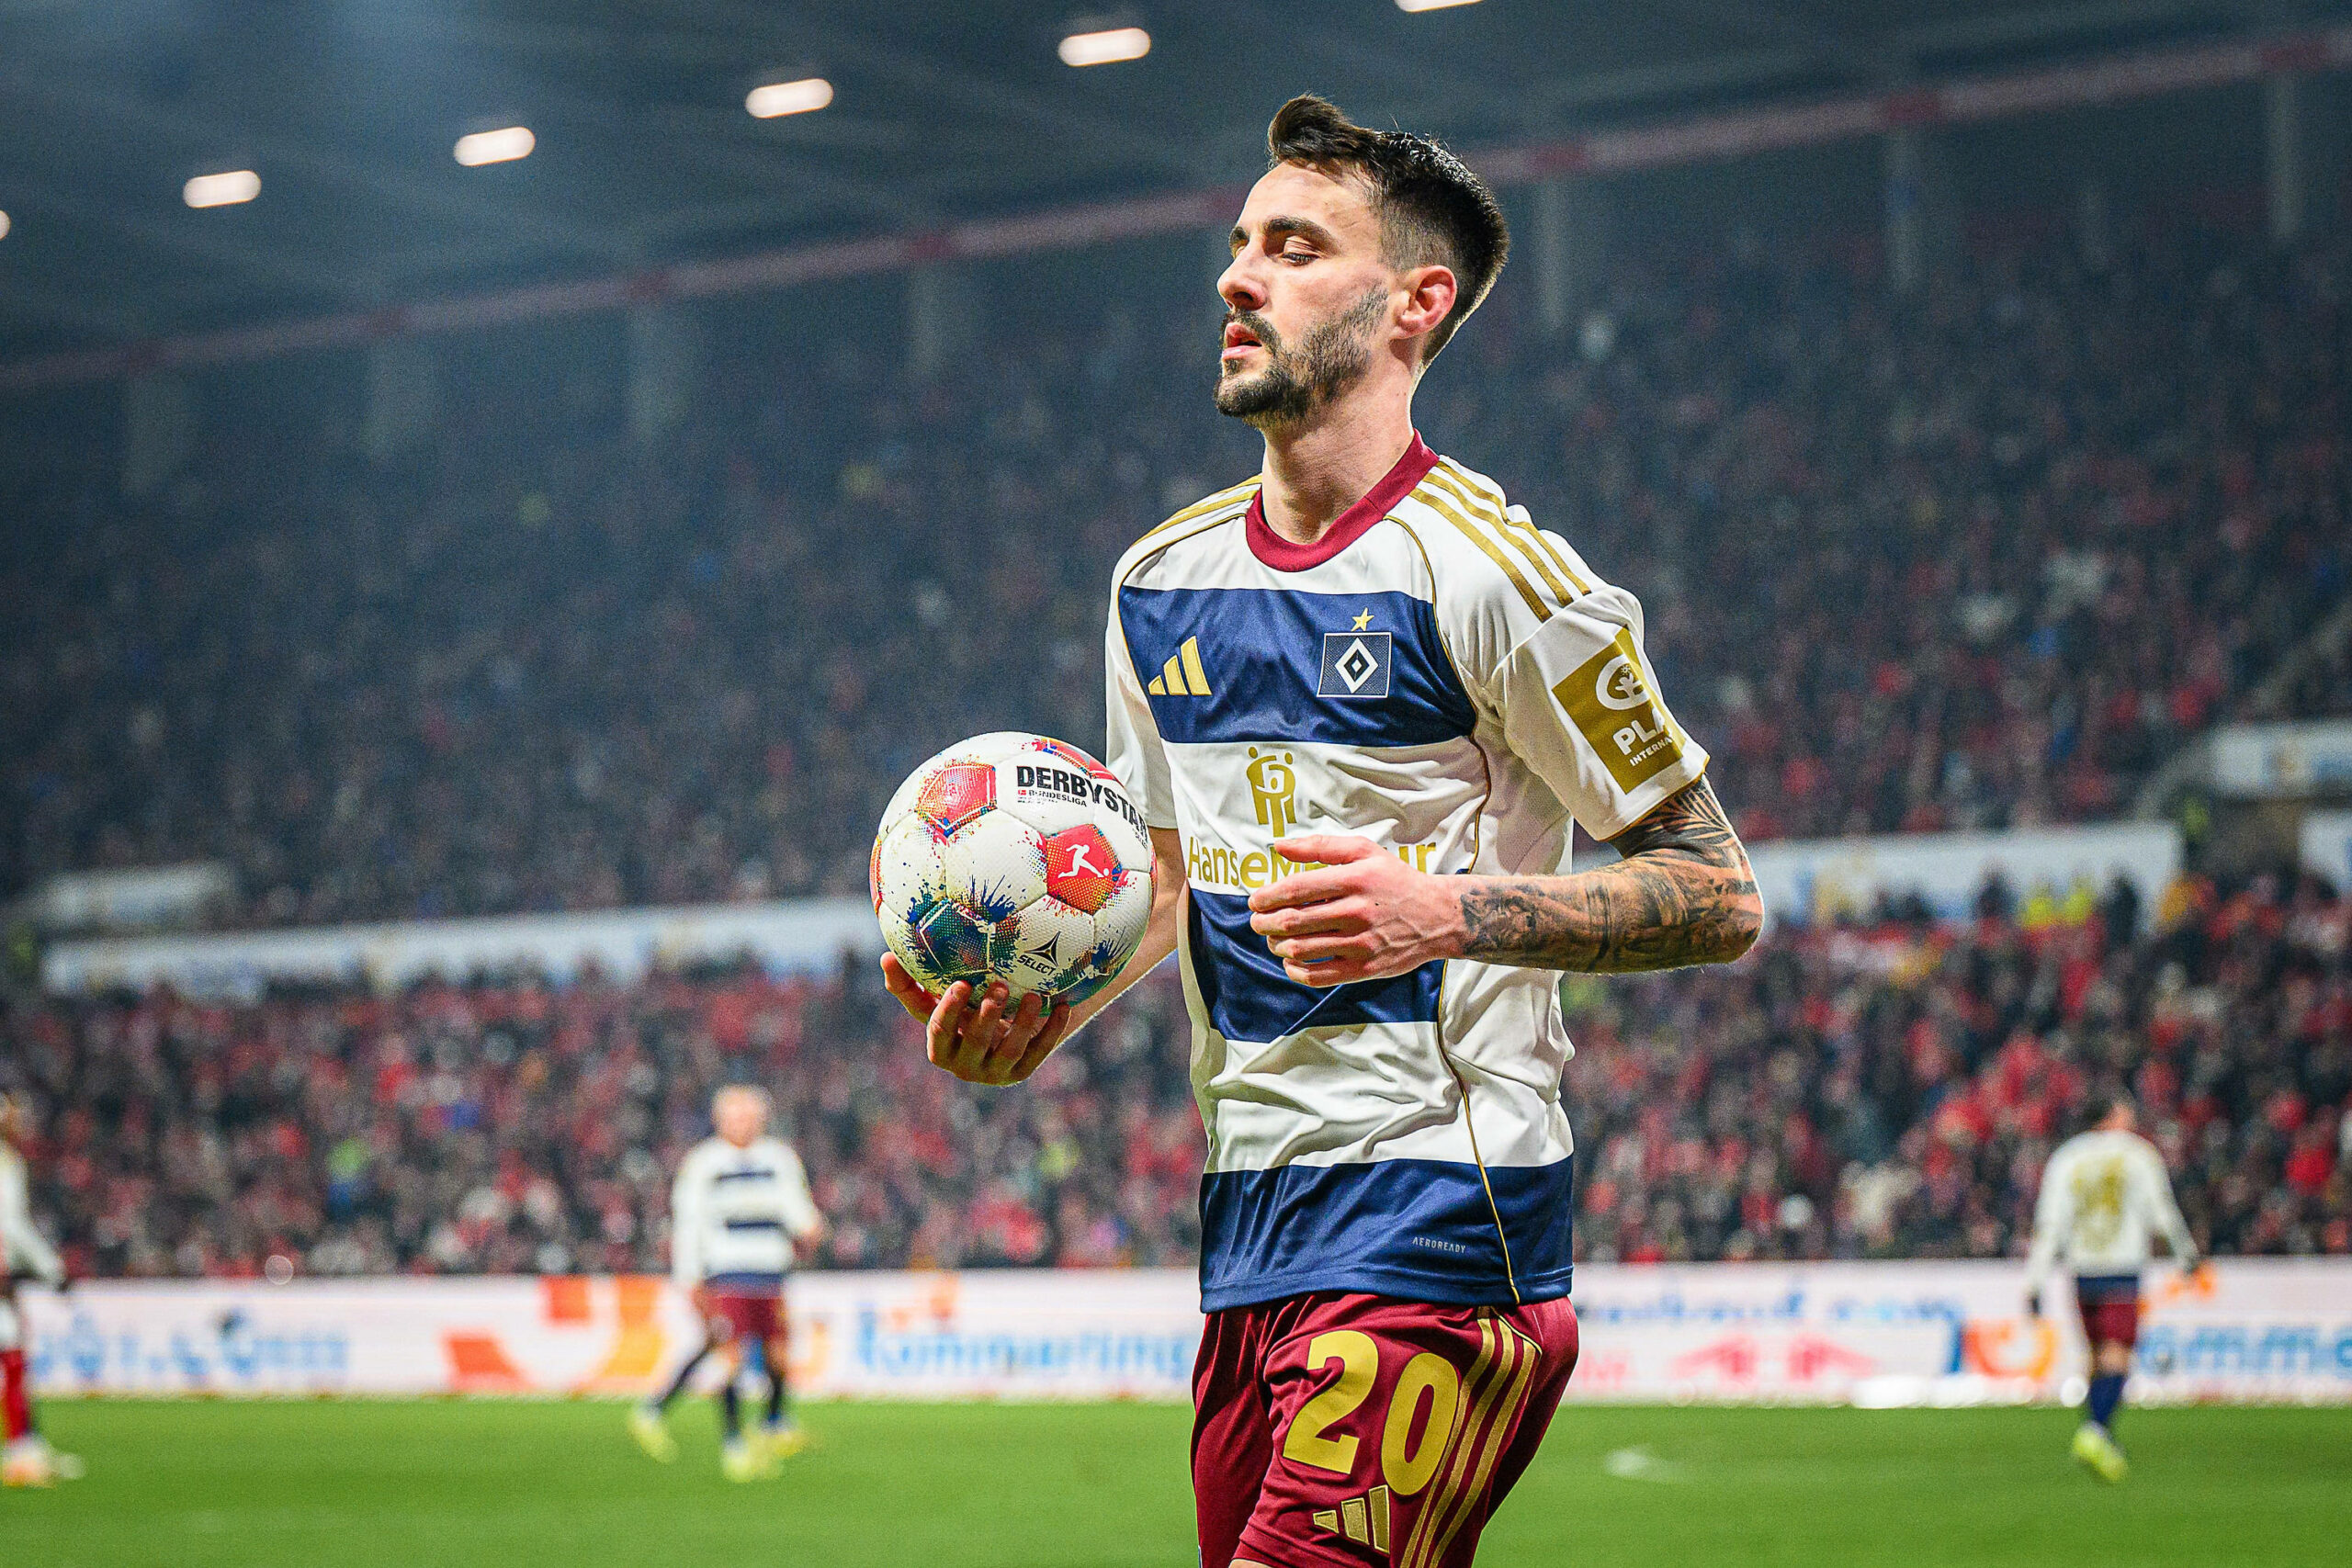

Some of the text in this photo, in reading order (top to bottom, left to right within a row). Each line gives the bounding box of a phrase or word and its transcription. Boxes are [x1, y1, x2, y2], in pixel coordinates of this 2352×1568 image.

[1016, 765, 1148, 843] DERBYSTAR
[1017, 954, 1057, 976] SELECT
[1411, 1227, 1466, 1254] AEROREADY
[1283, 1329, 1460, 1496] 20
